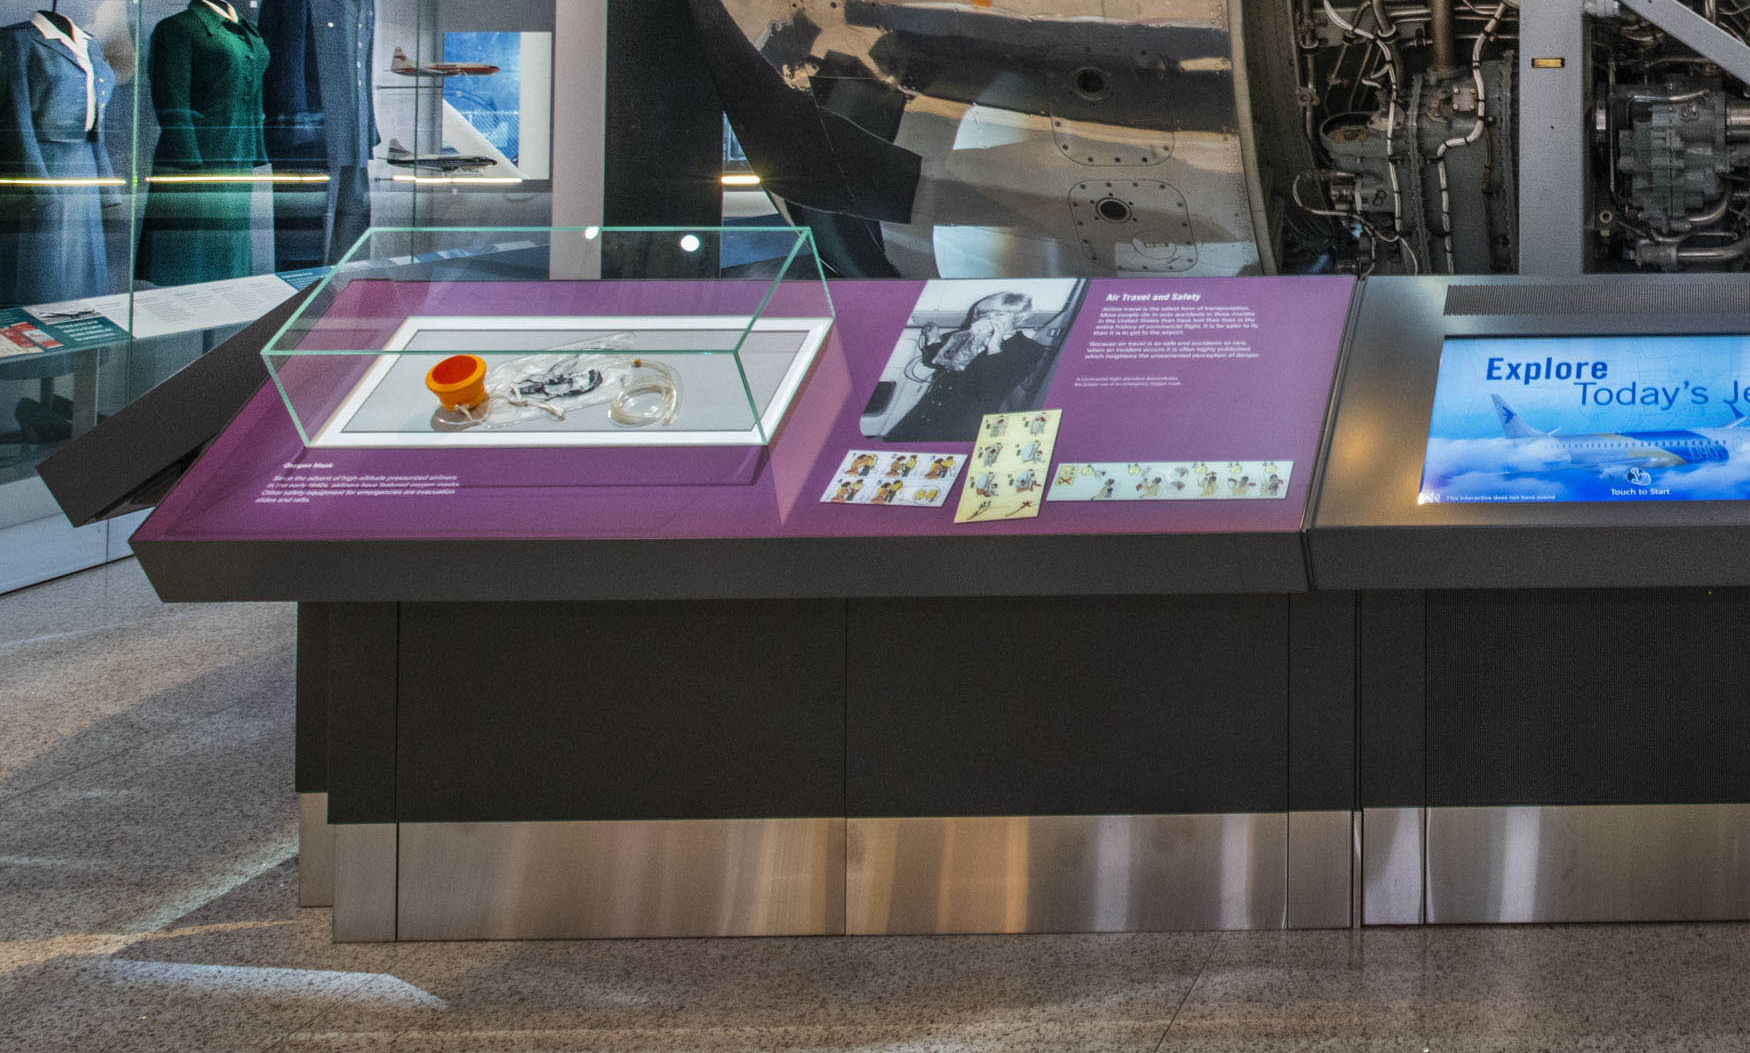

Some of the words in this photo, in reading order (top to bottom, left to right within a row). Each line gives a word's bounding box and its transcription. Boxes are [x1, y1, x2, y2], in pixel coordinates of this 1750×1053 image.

[1172, 293, 1201, 302] Safety
[1486, 357, 1608, 385] Explore
[1574, 381, 1709, 411] Today's
